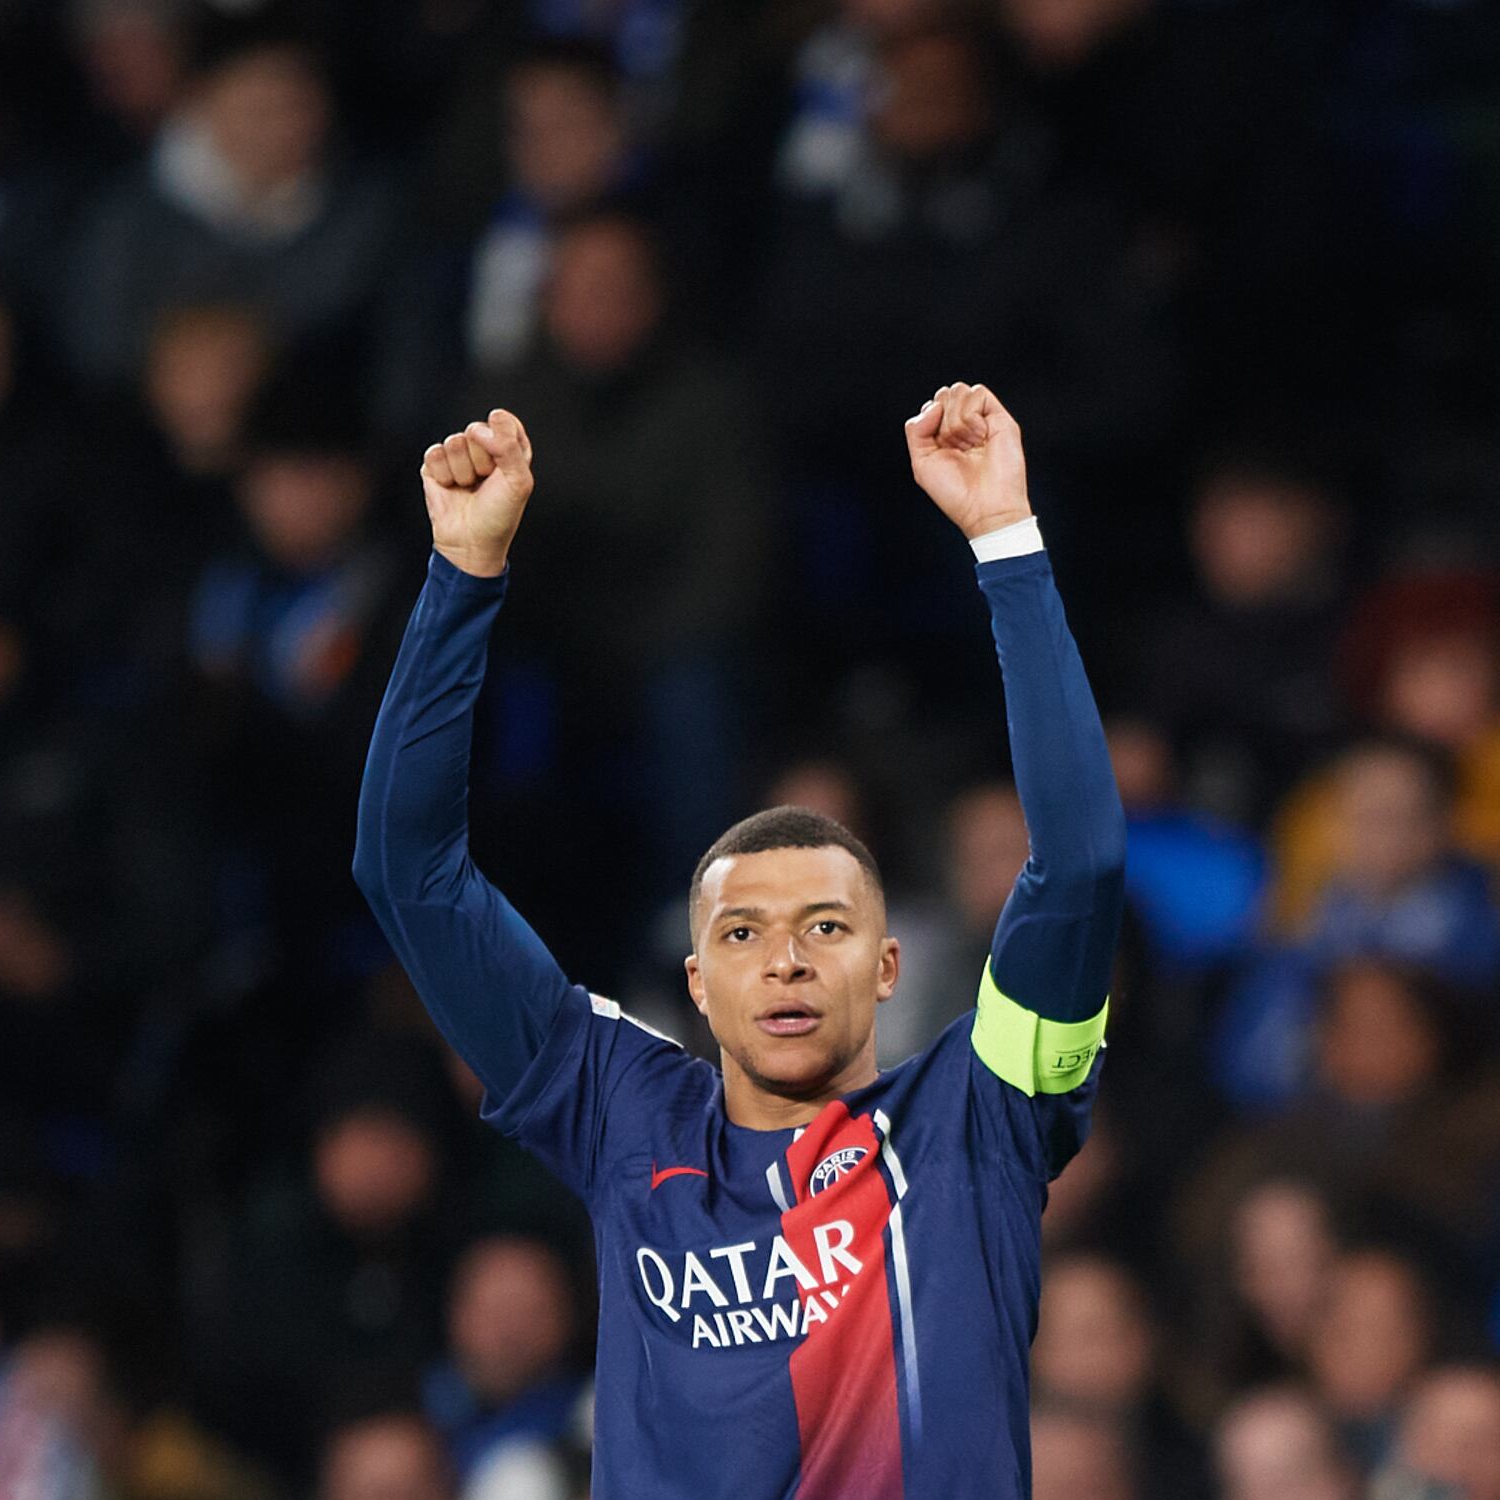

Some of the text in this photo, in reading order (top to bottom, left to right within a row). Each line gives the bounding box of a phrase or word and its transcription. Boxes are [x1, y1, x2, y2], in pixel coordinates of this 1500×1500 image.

[815, 1150, 855, 1180] PARIS
[636, 1219, 863, 1323] QATAR
[692, 1284, 850, 1349] AIRWAY
